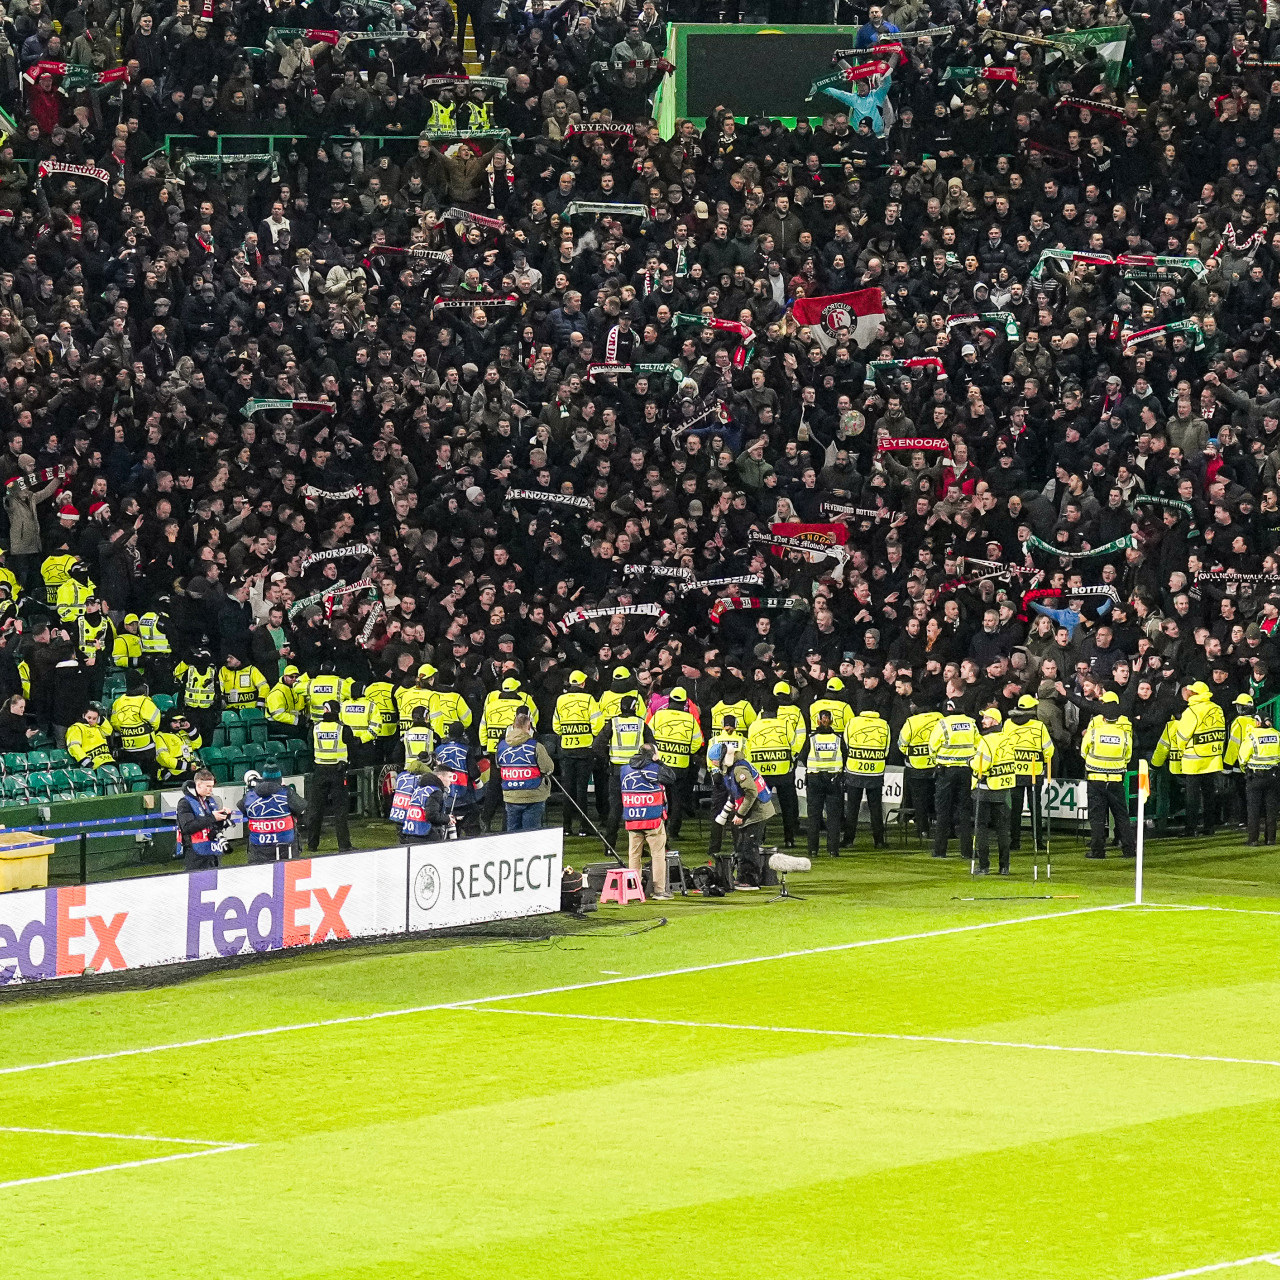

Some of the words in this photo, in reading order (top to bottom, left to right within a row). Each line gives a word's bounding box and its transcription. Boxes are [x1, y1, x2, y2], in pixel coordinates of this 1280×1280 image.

[822, 302, 852, 317] SPORTCLUB
[640, 363, 665, 371] CELTIC
[855, 509, 890, 520] ROTTERM
[1220, 572, 1243, 582] NEVER
[1243, 573, 1264, 582] WALK
[346, 705, 365, 714] POLICE
[318, 731, 338, 740] POLICE
[1100, 735, 1120, 744] POLICE
[1259, 736, 1278, 744] POLICE
[760, 764, 777, 773] 649
[858, 761, 876, 772] 208
[503, 769, 532, 779] PHOTO
[623, 795, 655, 804] PHOTO
[1045, 785, 1078, 811] 24
[629, 808, 647, 818] 017
[252, 819, 286, 832] PHOTO
[259, 833, 279, 844] 021
[451, 853, 557, 901] RESPECT
[186, 860, 353, 960] FedEx
